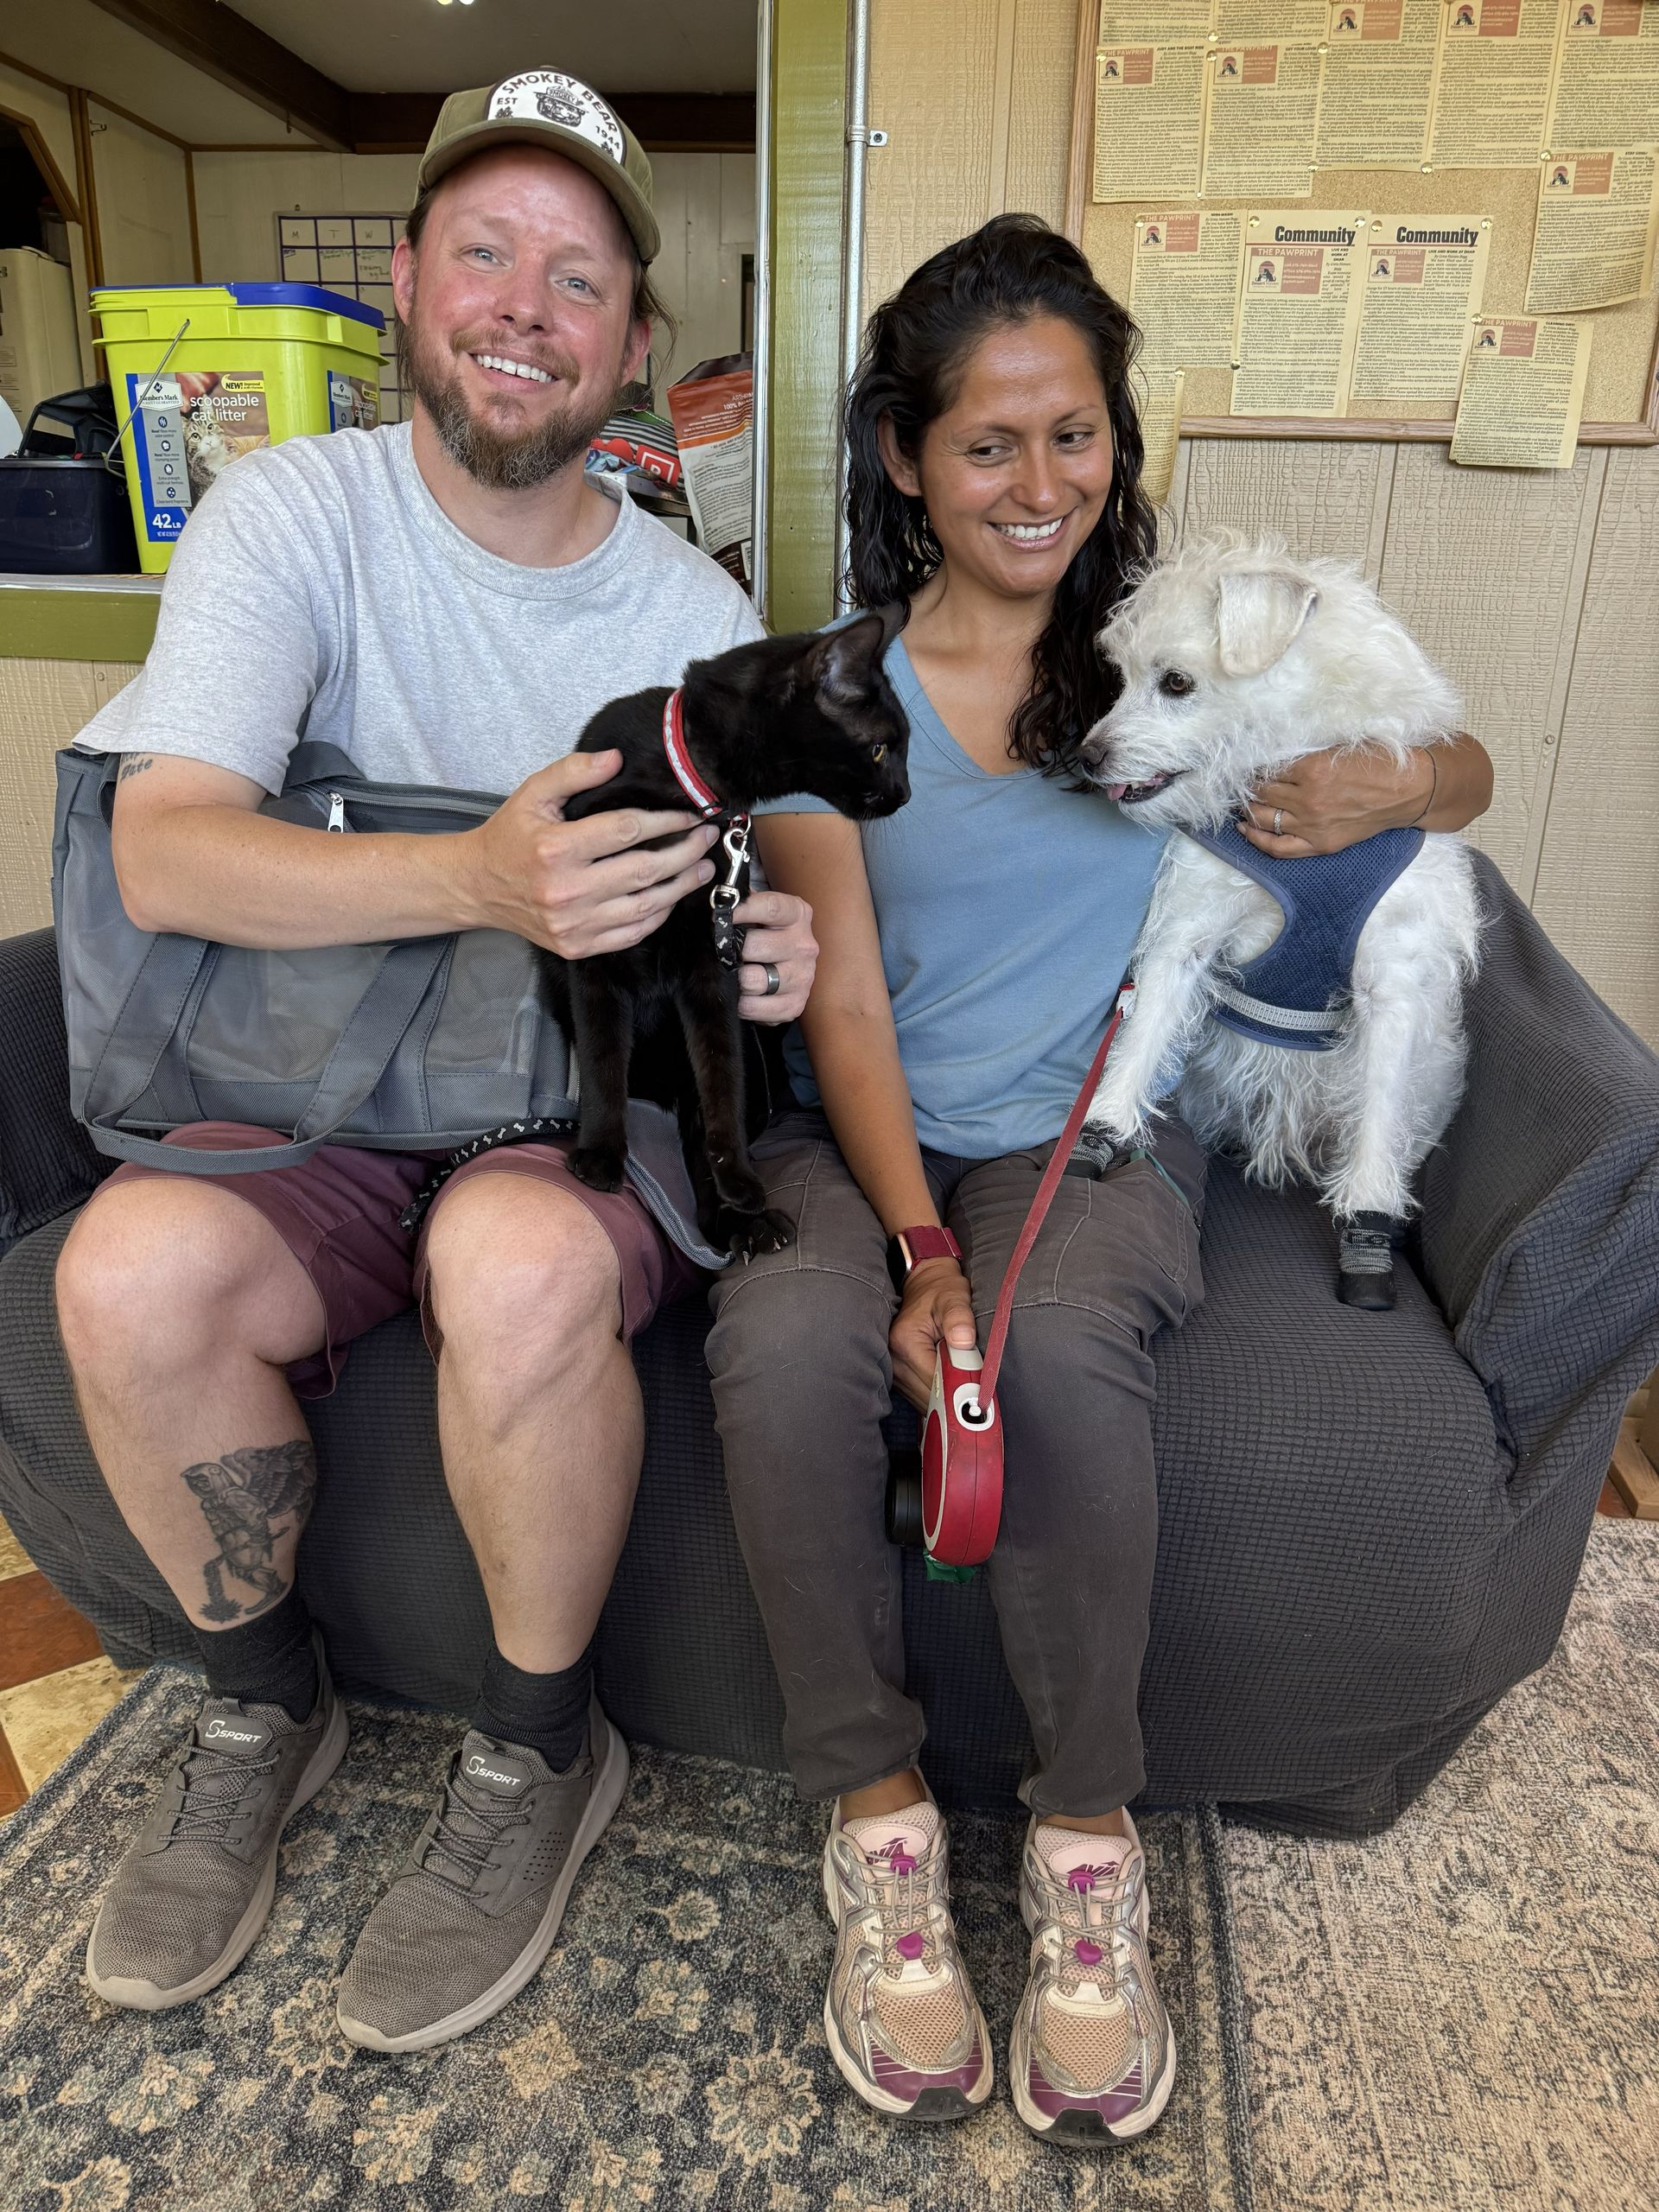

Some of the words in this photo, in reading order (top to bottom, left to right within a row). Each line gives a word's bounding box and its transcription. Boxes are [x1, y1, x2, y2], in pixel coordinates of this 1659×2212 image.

[497, 97, 518, 105] EST
[502, 73, 579, 94] SMOKEY
[582, 90, 618, 133] BEAR
[595, 125, 620, 149] 1944
[1274, 226, 1357, 247] Community
[1396, 226, 1479, 247] Community
[190, 394, 259, 410] scoopable
[192, 410, 213, 422] cat
[216, 409, 246, 422] litter
[152, 513, 172, 529] 42
[218, 1730, 262, 1743] SPORT
[477, 1768, 521, 1786] SPORT
